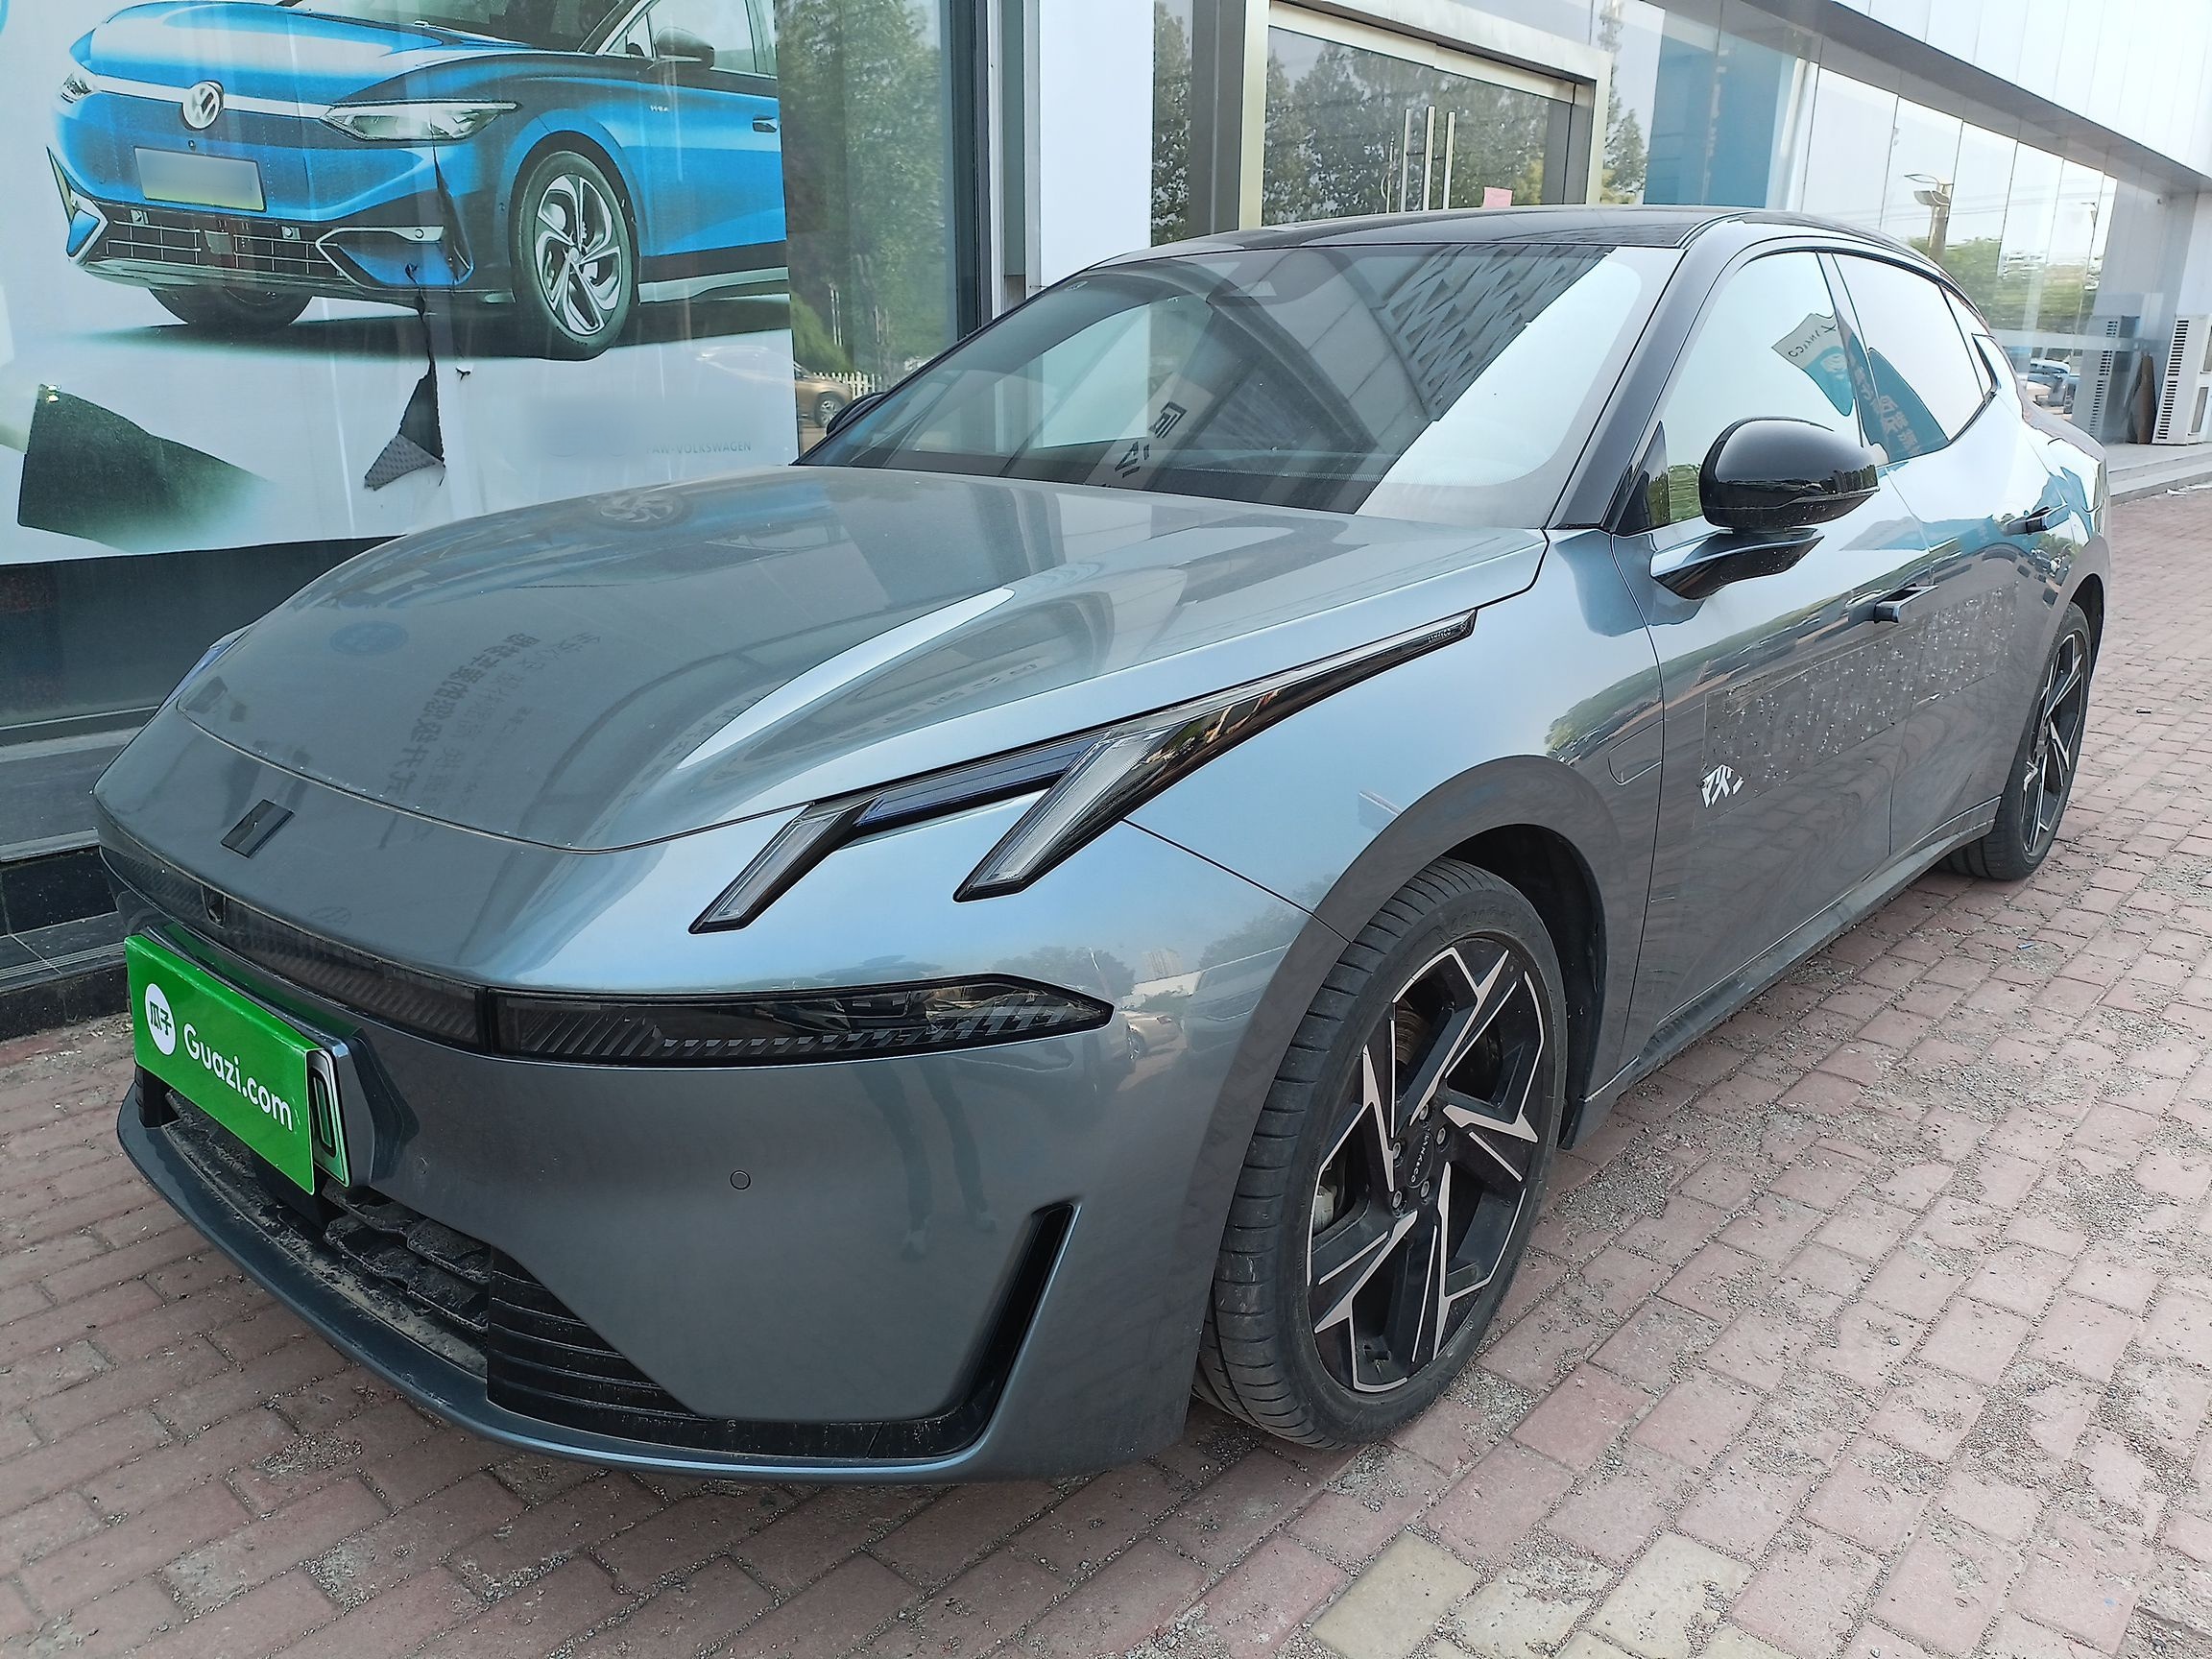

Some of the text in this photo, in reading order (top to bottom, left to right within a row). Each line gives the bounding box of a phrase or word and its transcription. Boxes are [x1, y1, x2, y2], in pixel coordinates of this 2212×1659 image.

[646, 441, 752, 455] FAW-VOLKSWAGEN
[150, 1001, 173, 1036] 瓜子
[183, 1023, 293, 1131] Guazi.com
